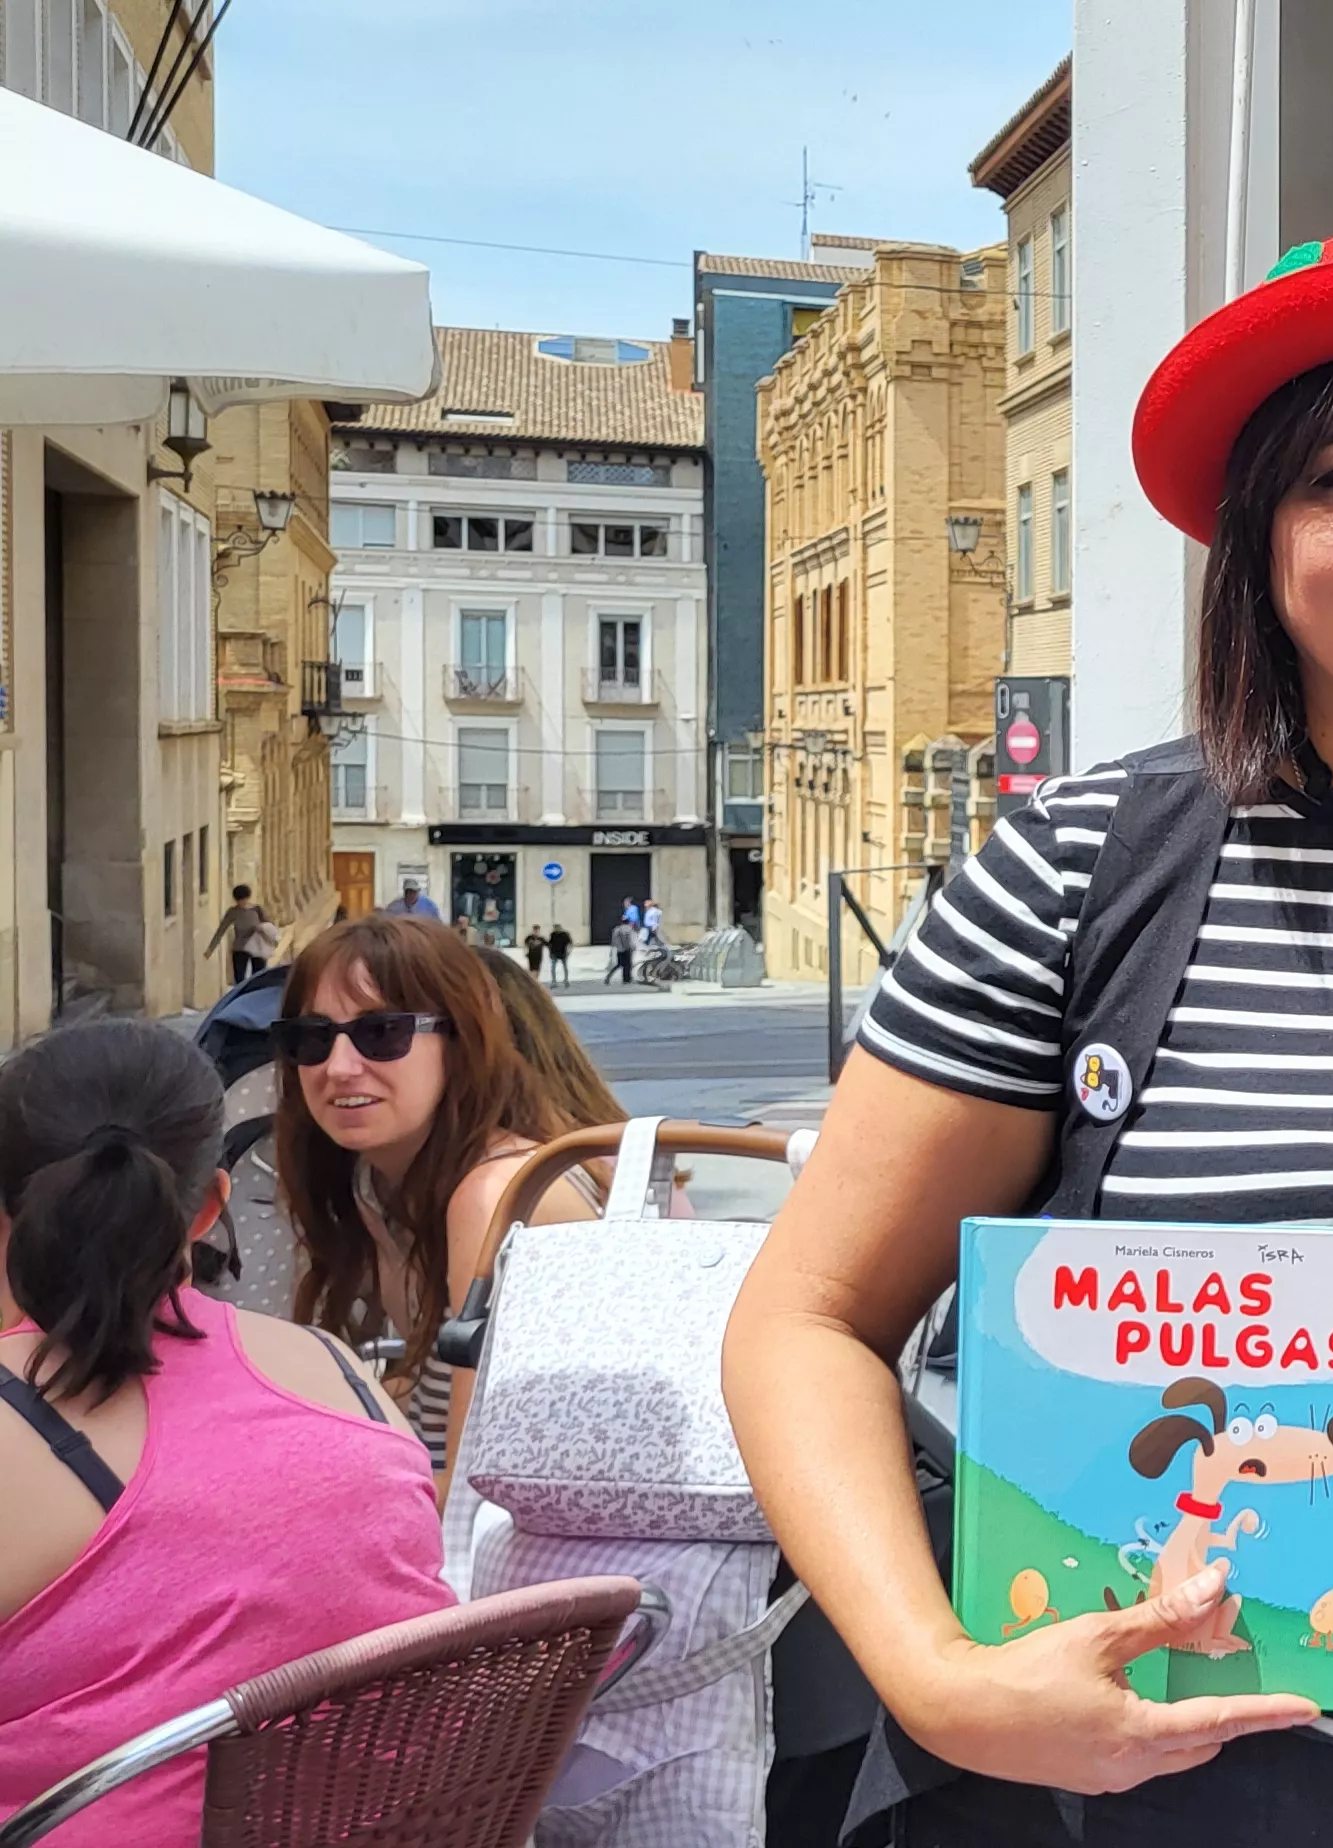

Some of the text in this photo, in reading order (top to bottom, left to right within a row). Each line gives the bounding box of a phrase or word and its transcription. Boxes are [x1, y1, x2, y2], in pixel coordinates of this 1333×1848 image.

[592, 830, 650, 846] INSIDE
[1114, 1245, 1215, 1260] Mariela Cisneros
[1053, 1265, 1274, 1318] MALAS
